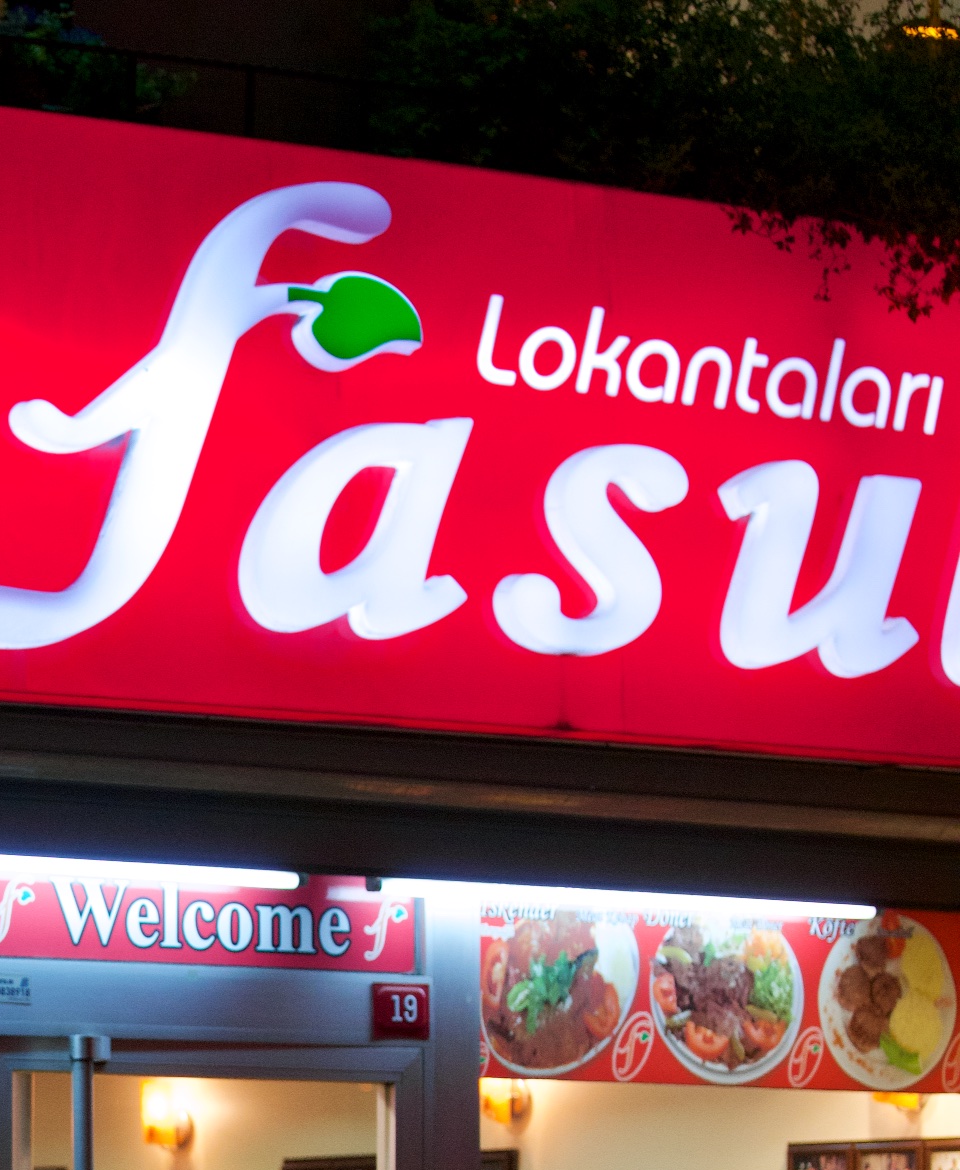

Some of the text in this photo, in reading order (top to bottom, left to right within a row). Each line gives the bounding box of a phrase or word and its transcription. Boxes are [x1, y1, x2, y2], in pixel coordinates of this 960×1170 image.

[476, 293, 945, 436] Lokantaları
[49, 874, 352, 958] Welcome
[391, 993, 418, 1024] 19
